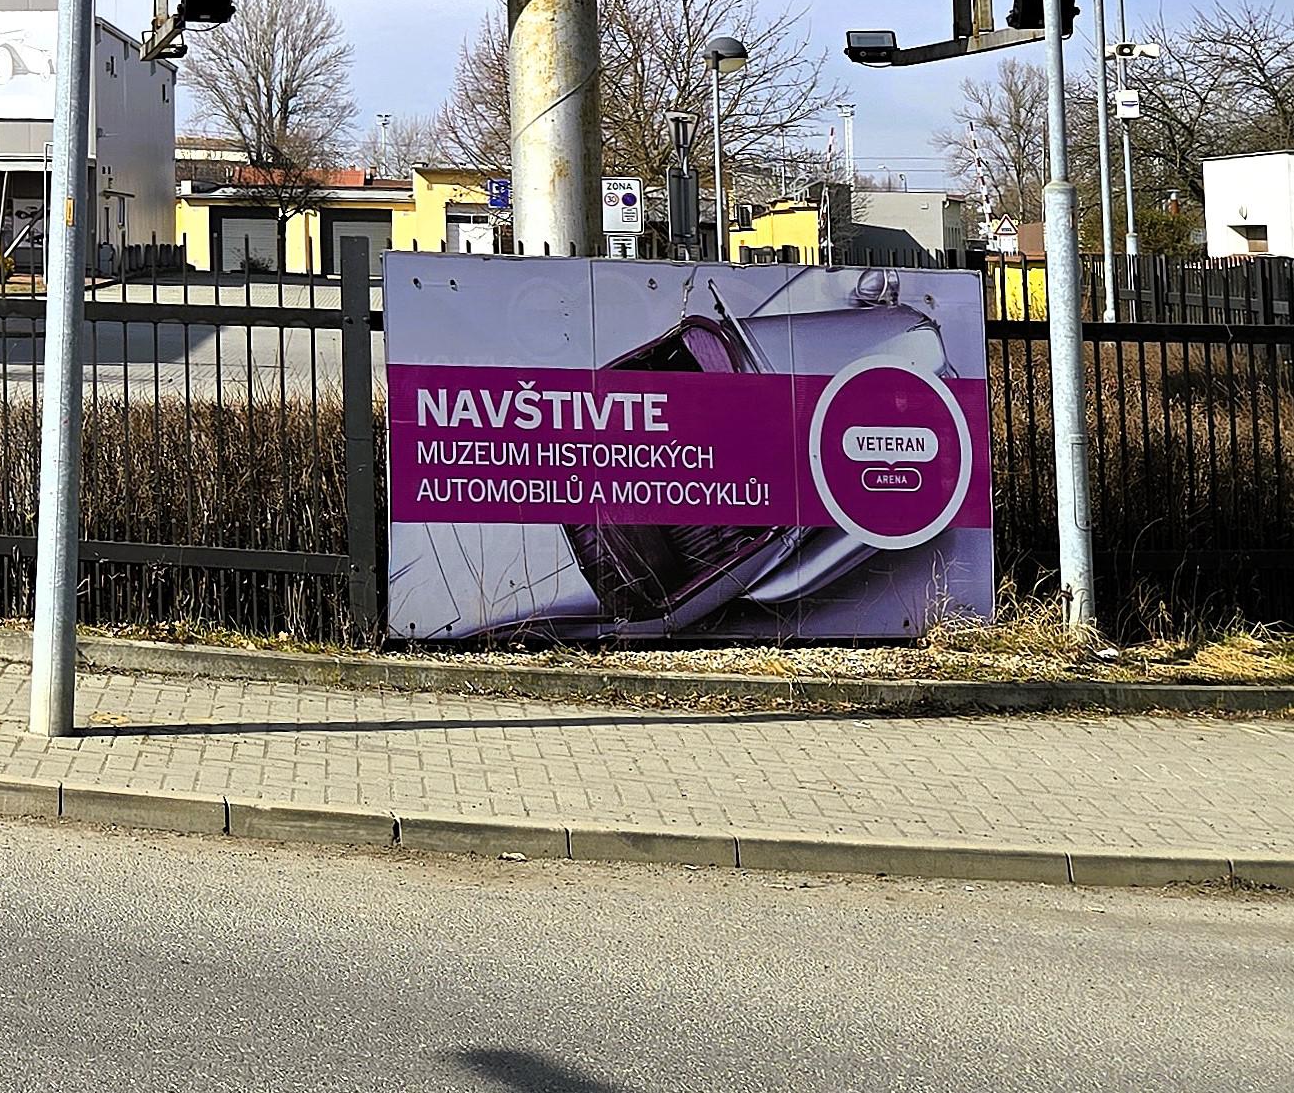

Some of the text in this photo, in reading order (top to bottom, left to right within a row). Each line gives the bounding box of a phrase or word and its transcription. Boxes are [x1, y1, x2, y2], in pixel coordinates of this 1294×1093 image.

[416, 380, 670, 432] NAVŠTIVTE
[416, 439, 714, 469] MUZEUM HISTORICKÝCH
[856, 436, 925, 452] VETERAN
[416, 474, 771, 507] AUTOMOBILŮ A MOTOCYKLŮ!
[876, 475, 908, 485] ARENA
